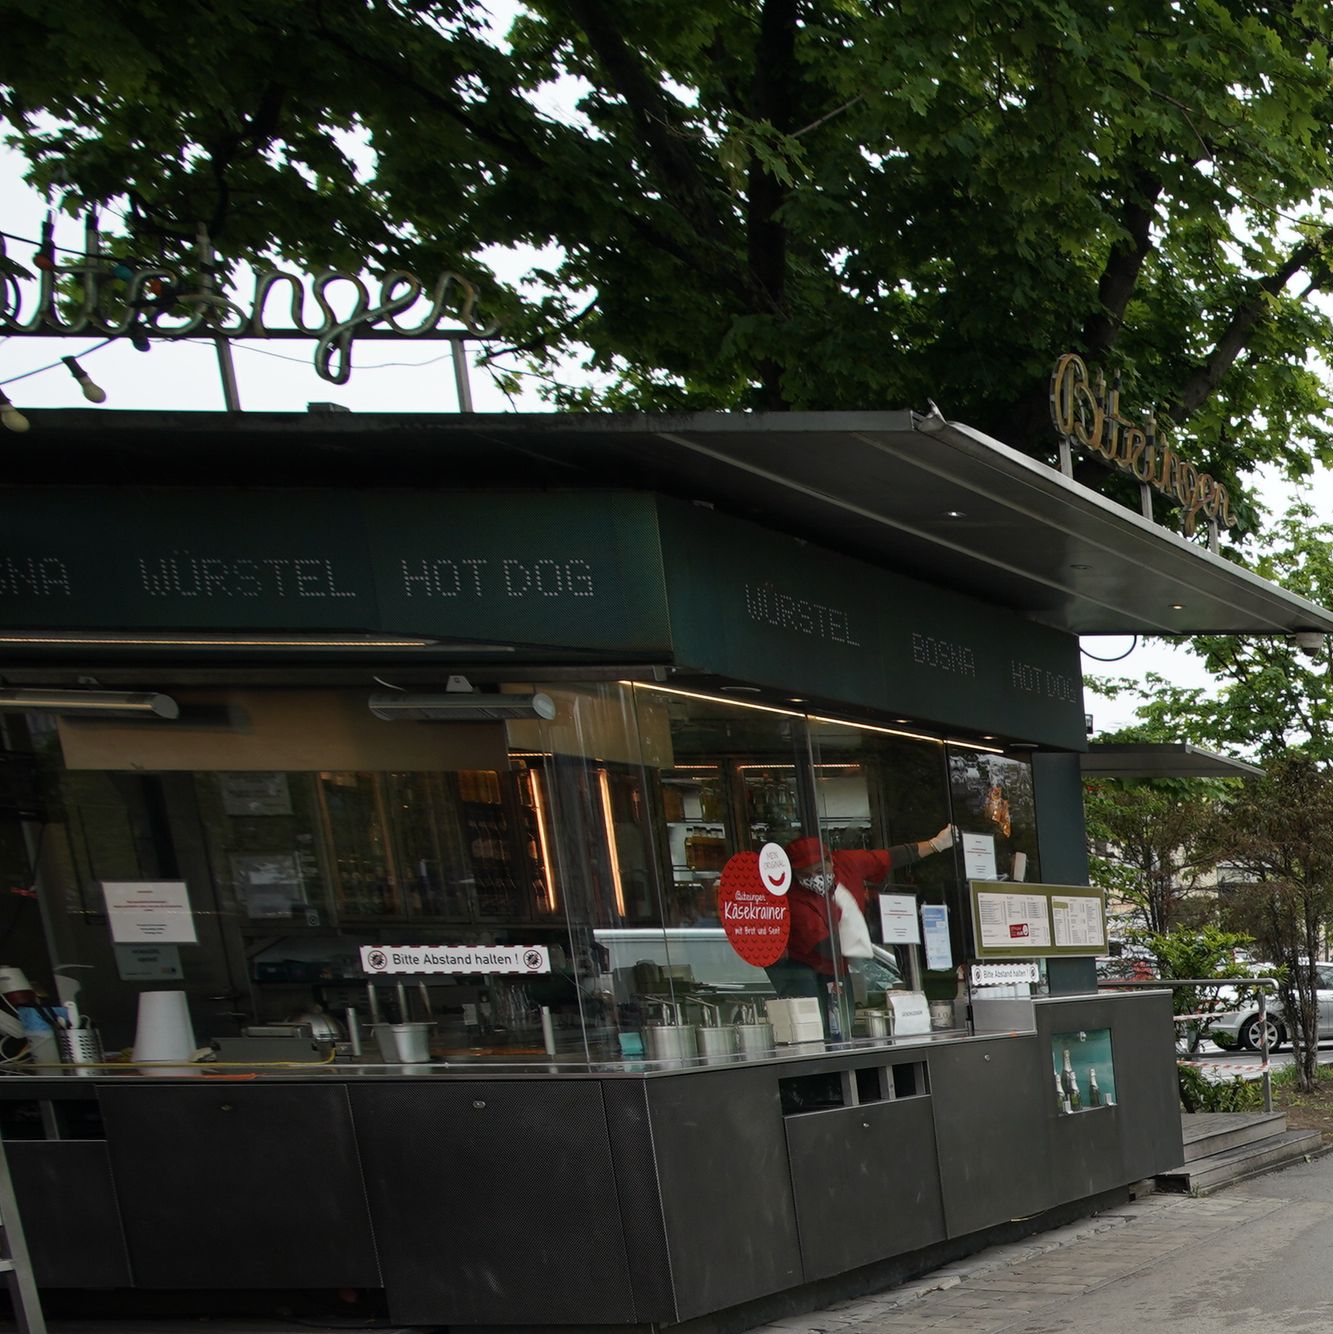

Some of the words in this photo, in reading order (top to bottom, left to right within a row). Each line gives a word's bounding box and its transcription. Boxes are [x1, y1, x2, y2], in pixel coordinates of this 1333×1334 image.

[1050, 353, 1238, 537] Bitzinger
[139, 549, 357, 596] WÜRSTEL
[401, 559, 488, 596] HOT
[502, 559, 594, 596] DOG
[744, 582, 860, 647] WÜRSTEL
[911, 632, 976, 677] BOSNA
[1011, 660, 1042, 694] HOT
[725, 901, 787, 920] Käsekrainer
[744, 926, 756, 935] Brot
[757, 926, 767, 935] und
[392, 953, 420, 965] Bitte
[423, 953, 472, 965] Abstand
[475, 953, 512, 965] halten
[515, 953, 519, 965] !
[983, 970, 993, 978] Bitte
[994, 969, 1012, 978] Abstand
[1013, 968, 1026, 977] halten
